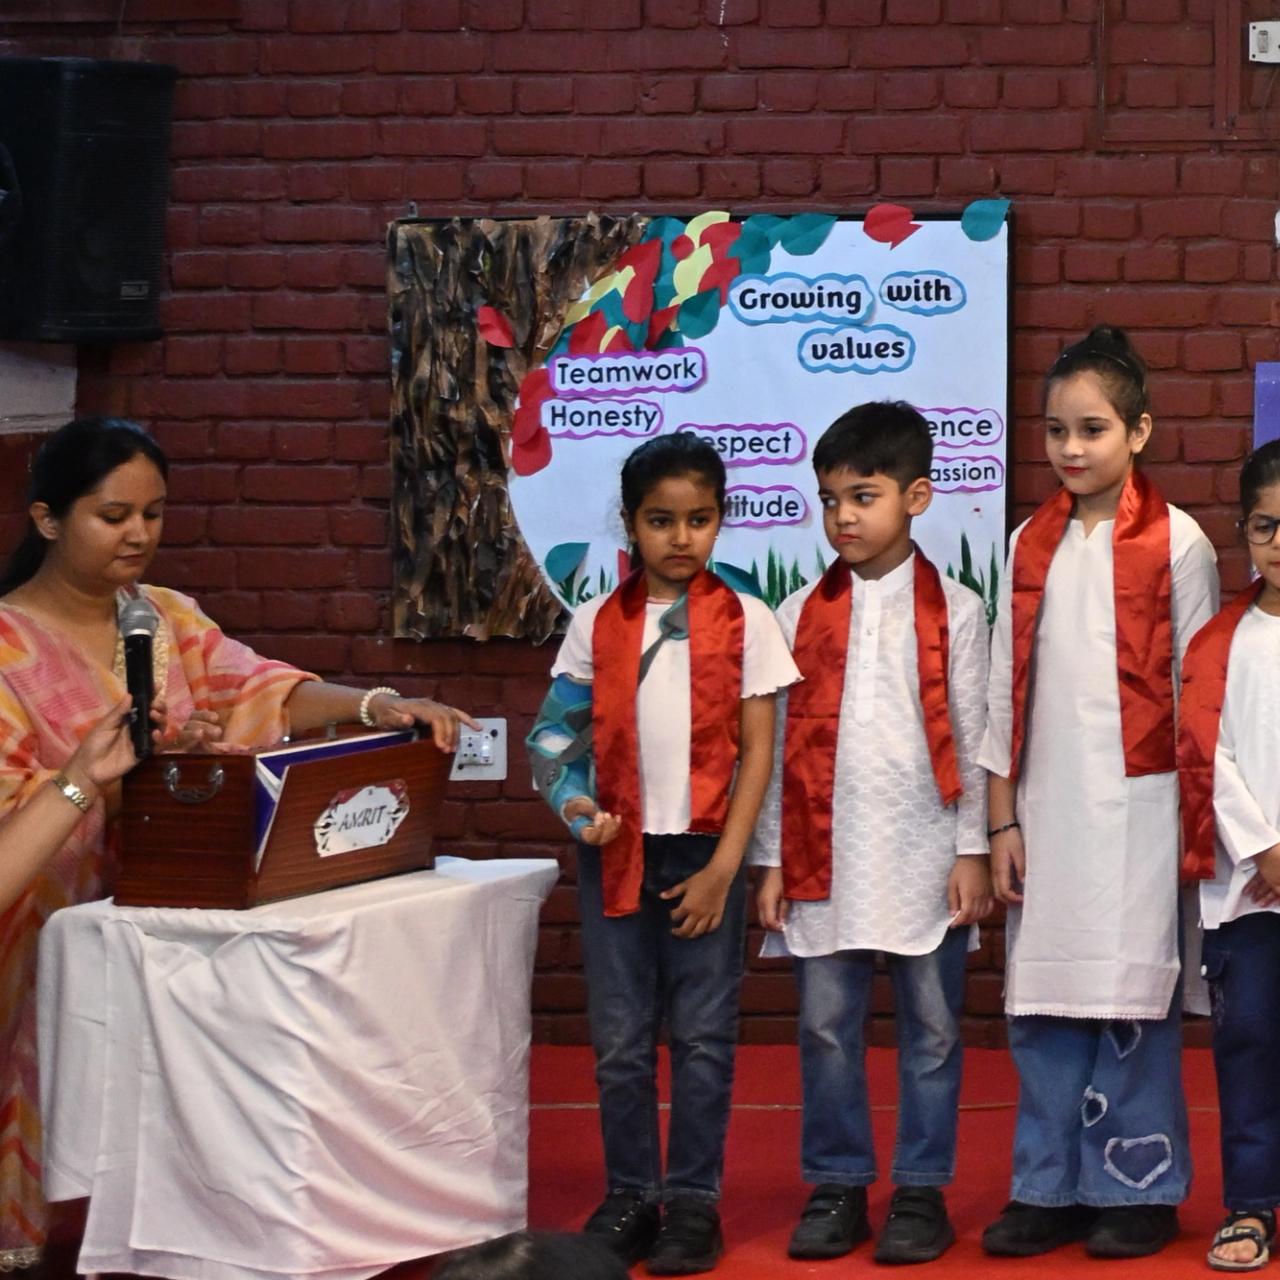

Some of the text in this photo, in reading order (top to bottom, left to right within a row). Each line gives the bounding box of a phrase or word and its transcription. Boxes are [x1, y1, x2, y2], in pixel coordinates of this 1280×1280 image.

[738, 279, 952, 314] Growing with
[811, 337, 906, 361] values
[557, 358, 697, 385] Teamwork
[550, 405, 659, 432] Honesty
[700, 431, 792, 458] espect
